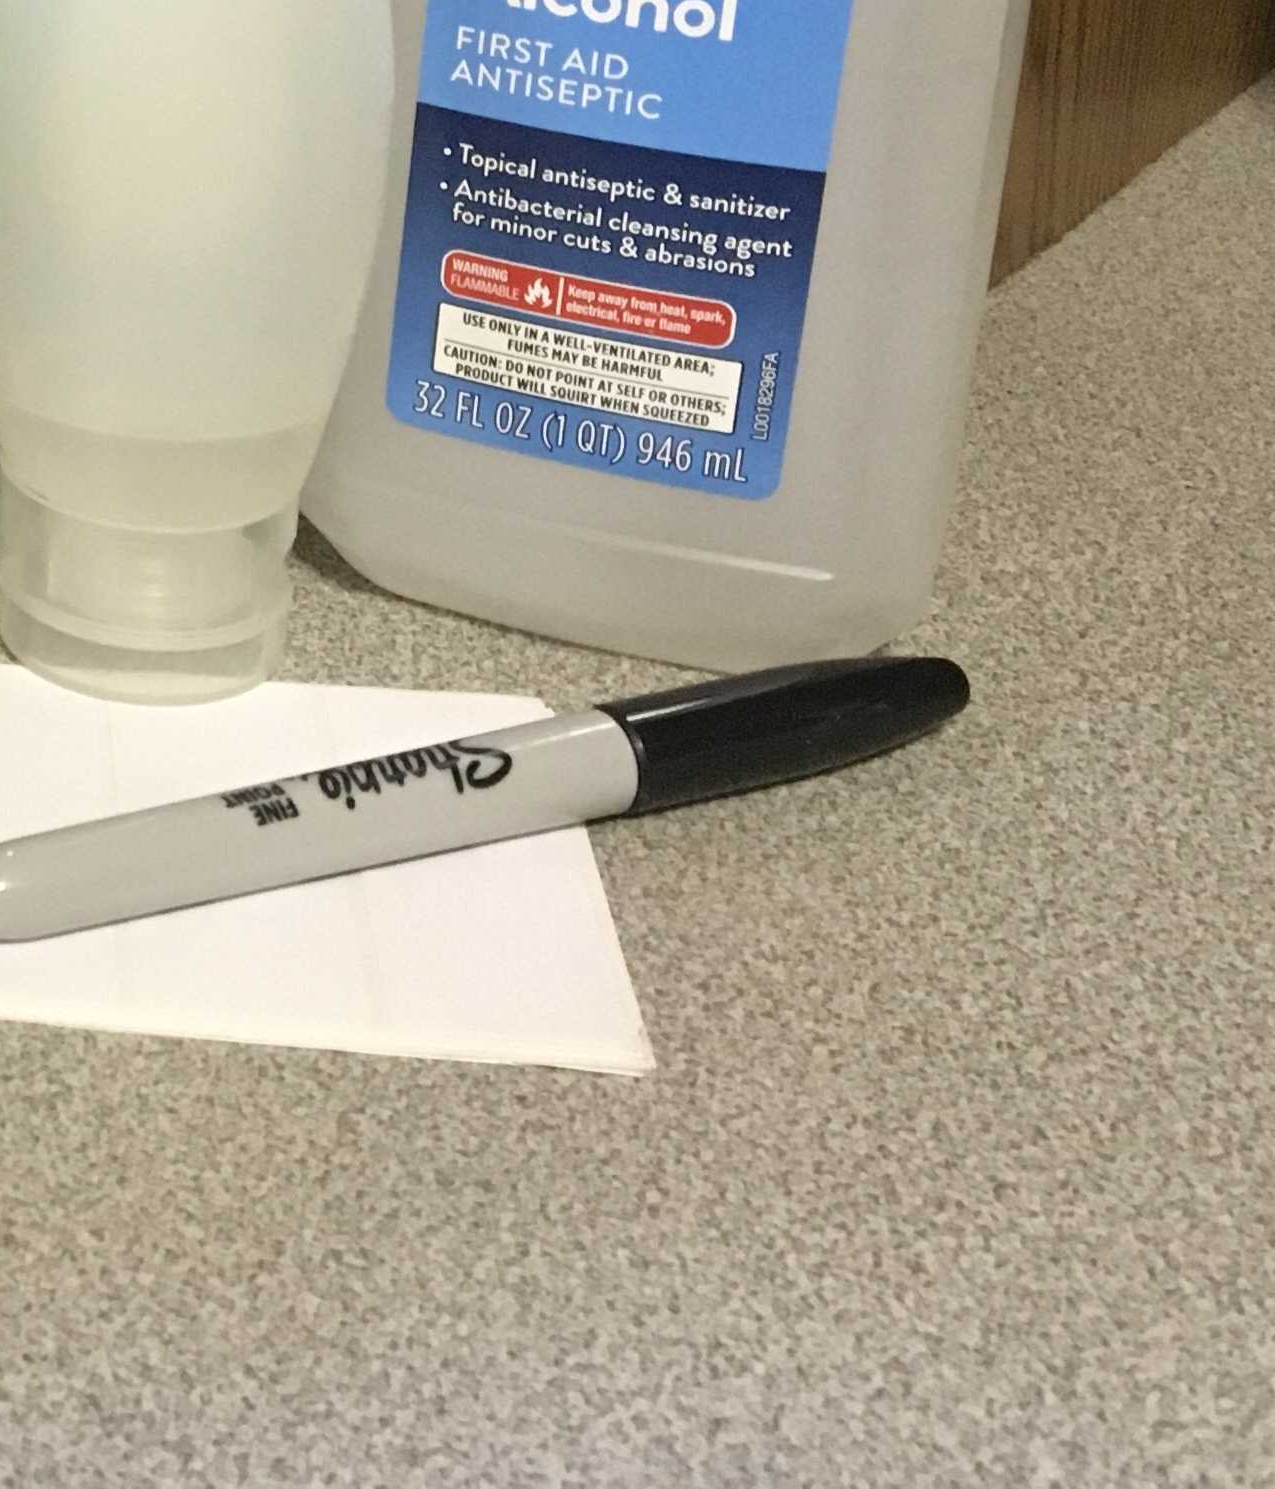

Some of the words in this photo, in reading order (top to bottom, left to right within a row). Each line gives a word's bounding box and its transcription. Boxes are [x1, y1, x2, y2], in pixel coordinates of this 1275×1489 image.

[456, 25, 553, 68] FIRST
[562, 49, 629, 79] AID
[451, 60, 663, 120] ANTISEPTIC
[459, 143, 537, 180] Topical
[542, 165, 655, 203] antiseptic
[664, 184, 683, 205] &
[690, 188, 791, 221] sanitizer
[452, 204, 484, 227] for
[490, 214, 557, 243] minor
[563, 230, 611, 255] cuts
[619, 236, 638, 258] &
[645, 243, 756, 278] abrasions
[454, 183, 601, 227] Antibacterial
[609, 211, 717, 255] cleansing
[725, 234, 793, 262] agent
[450, 275, 519, 301] FLAMMABLE
[452, 258, 508, 282] WARNING
[568, 285, 596, 302] Keep
[598, 292, 628, 308] away
[630, 296, 658, 313] from
[622, 310, 641, 325] fire
[644, 316, 657, 327] or
[659, 316, 692, 335] flame
[463, 313, 485, 331] USE
[488, 318, 522, 339] ONLY
[524, 325, 538, 340] IN
[541, 330, 550, 343] A
[553, 332, 671, 368] WELL-VENTILATED
[507, 338, 549, 359] FUMES
[551, 347, 578, 364] MAY
[582, 354, 598, 368] BE
[601, 358, 663, 382] HARMFUL
[443, 344, 502, 371] CAUTION:
[505, 359, 523, 374] DO
[526, 364, 552, 381] NOT
[555, 370, 594, 390] POINT
[597, 380, 613, 394] AT
[616, 383, 644, 401] SELF
[650, 389, 667, 404] OR
[455, 363, 513, 389] PRODUCT
[517, 376, 548, 395] WILL
[550, 384, 597, 406] SQUIRT
[600, 396, 639, 415] WHEN
[642, 403, 709, 428] SQUEEZED
[413, 380, 445, 418] 32
[456, 391, 484, 429] FL
[495, 401, 531, 440] OZ
[542, 412, 567, 450] (1
[577, 420, 626, 464] QT)
[639, 432, 692, 472] 946
[703, 447, 748, 483] mL
[220, 784, 285, 809] POINT
[319, 740, 512, 810] Sharpie
[253, 797, 299, 827] FINE
